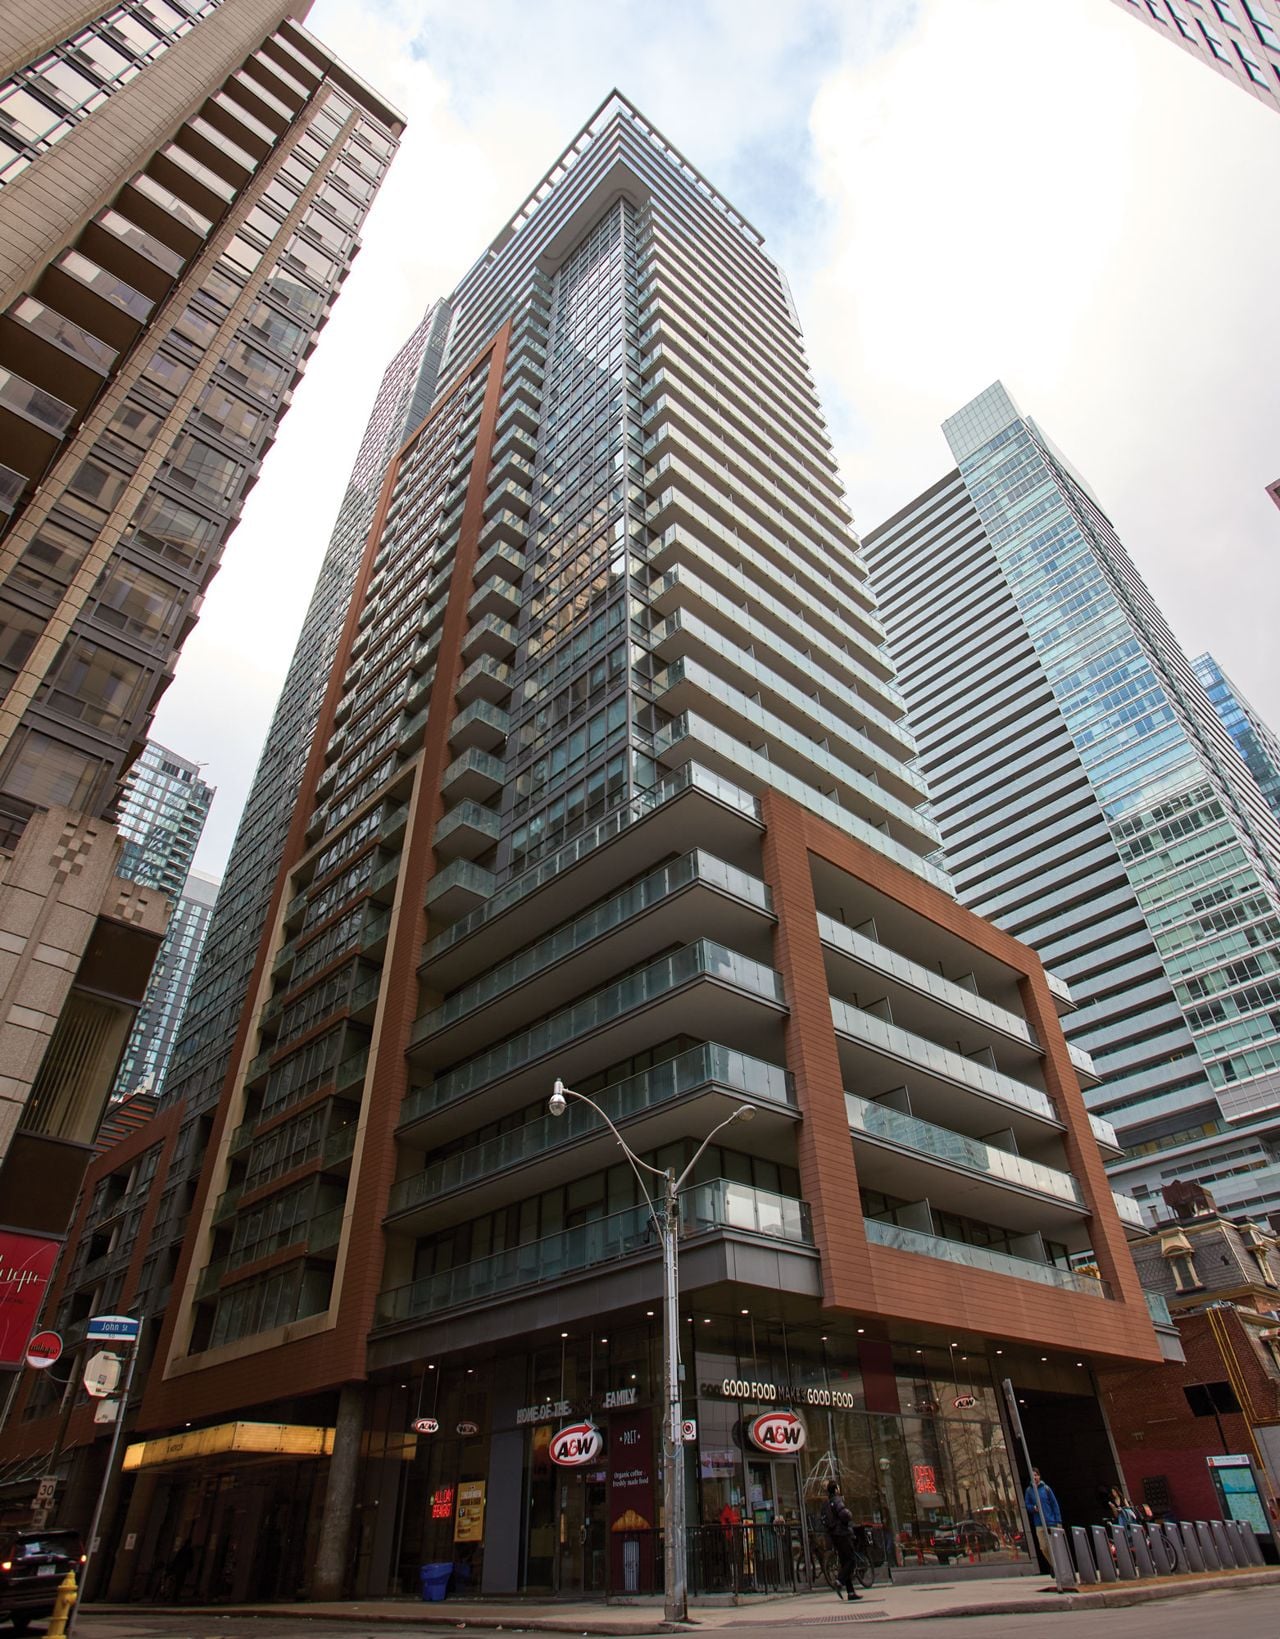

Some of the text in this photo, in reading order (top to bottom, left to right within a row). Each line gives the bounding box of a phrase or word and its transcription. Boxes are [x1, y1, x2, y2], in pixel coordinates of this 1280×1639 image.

[101, 1322, 119, 1332] John
[604, 1387, 638, 1408] FAMILY
[722, 1378, 750, 1398] GOOD
[751, 1381, 777, 1401] FOOD
[807, 1388, 831, 1406] GOOD
[832, 1390, 854, 1408] FOOD
[553, 1399, 573, 1417] THE
[762, 1425, 802, 1445] A&W
[556, 1436, 595, 1459] A&W
[39, 1484, 54, 1496] 30
